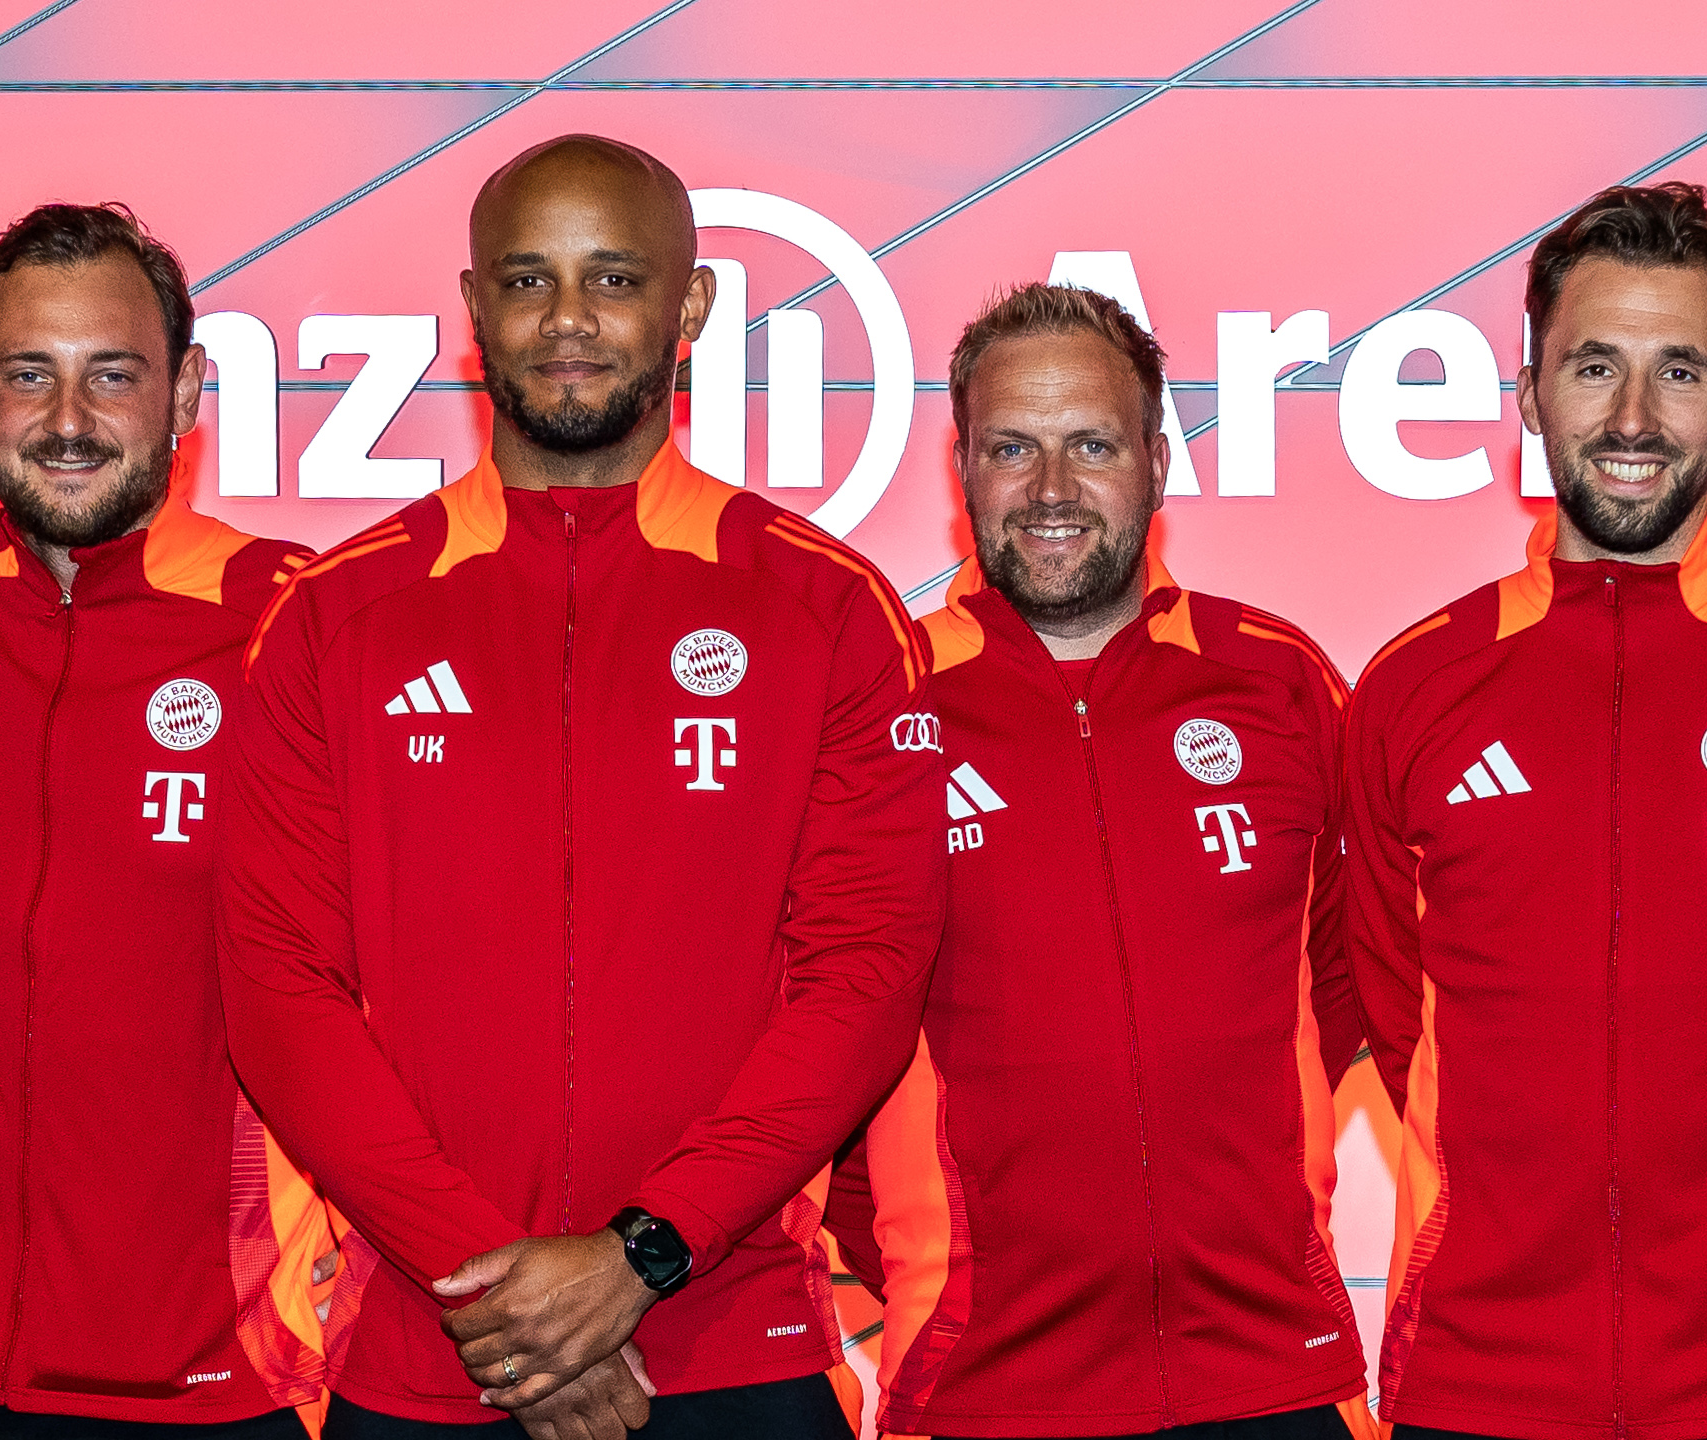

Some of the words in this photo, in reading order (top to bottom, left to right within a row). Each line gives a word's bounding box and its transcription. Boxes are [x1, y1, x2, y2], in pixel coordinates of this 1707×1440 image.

[693, 634, 741, 658] BAYERN
[171, 684, 215, 710] BAYERN
[1189, 724, 1233, 746] BAYERN
[947, 822, 985, 854] AD
